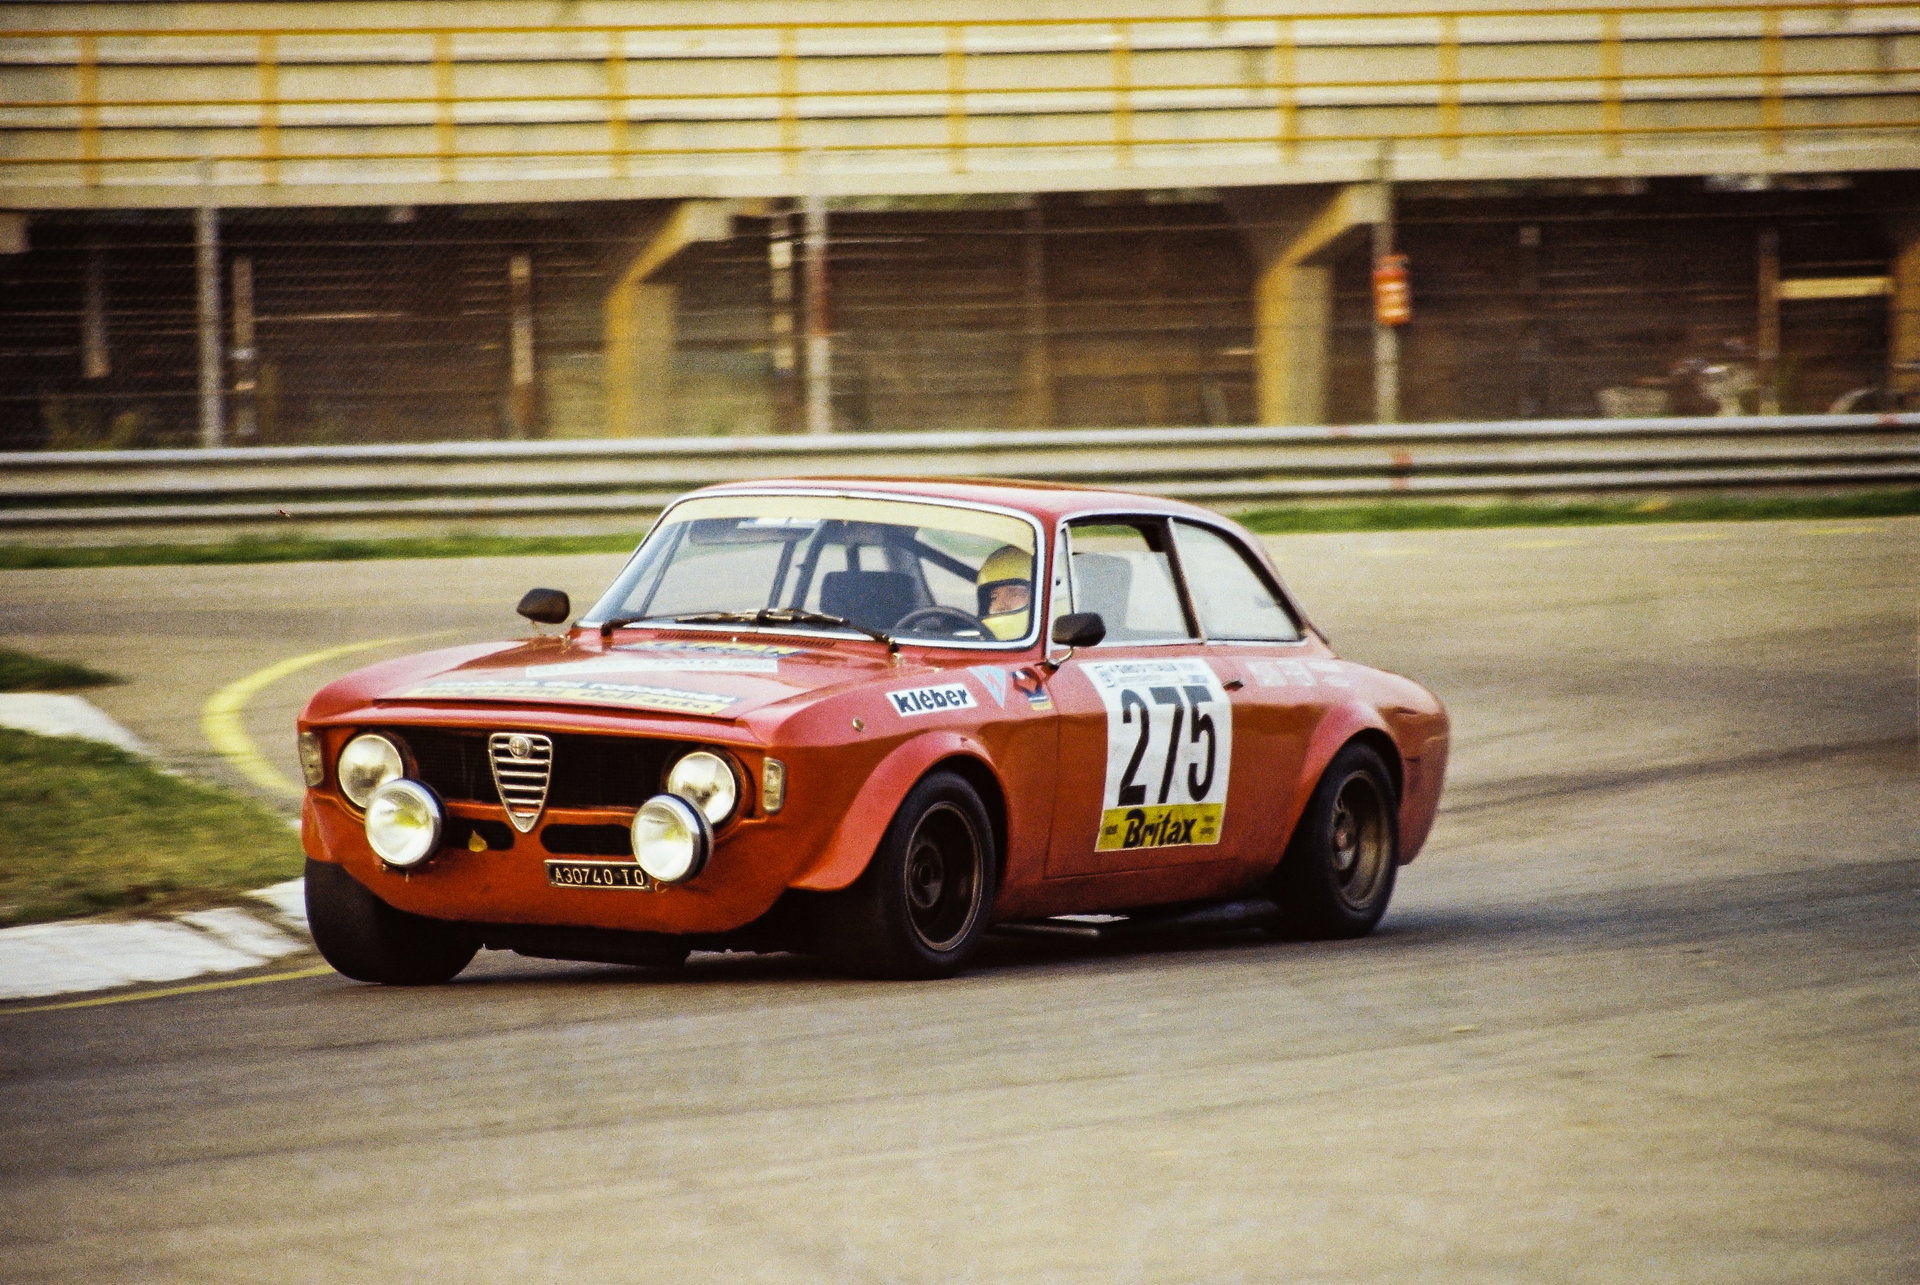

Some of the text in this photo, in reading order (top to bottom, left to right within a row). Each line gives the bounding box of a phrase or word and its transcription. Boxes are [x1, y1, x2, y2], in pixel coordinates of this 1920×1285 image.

[1117, 685, 1216, 806] 275
[1122, 808, 1198, 849] Britax
[555, 867, 613, 885] A30740
